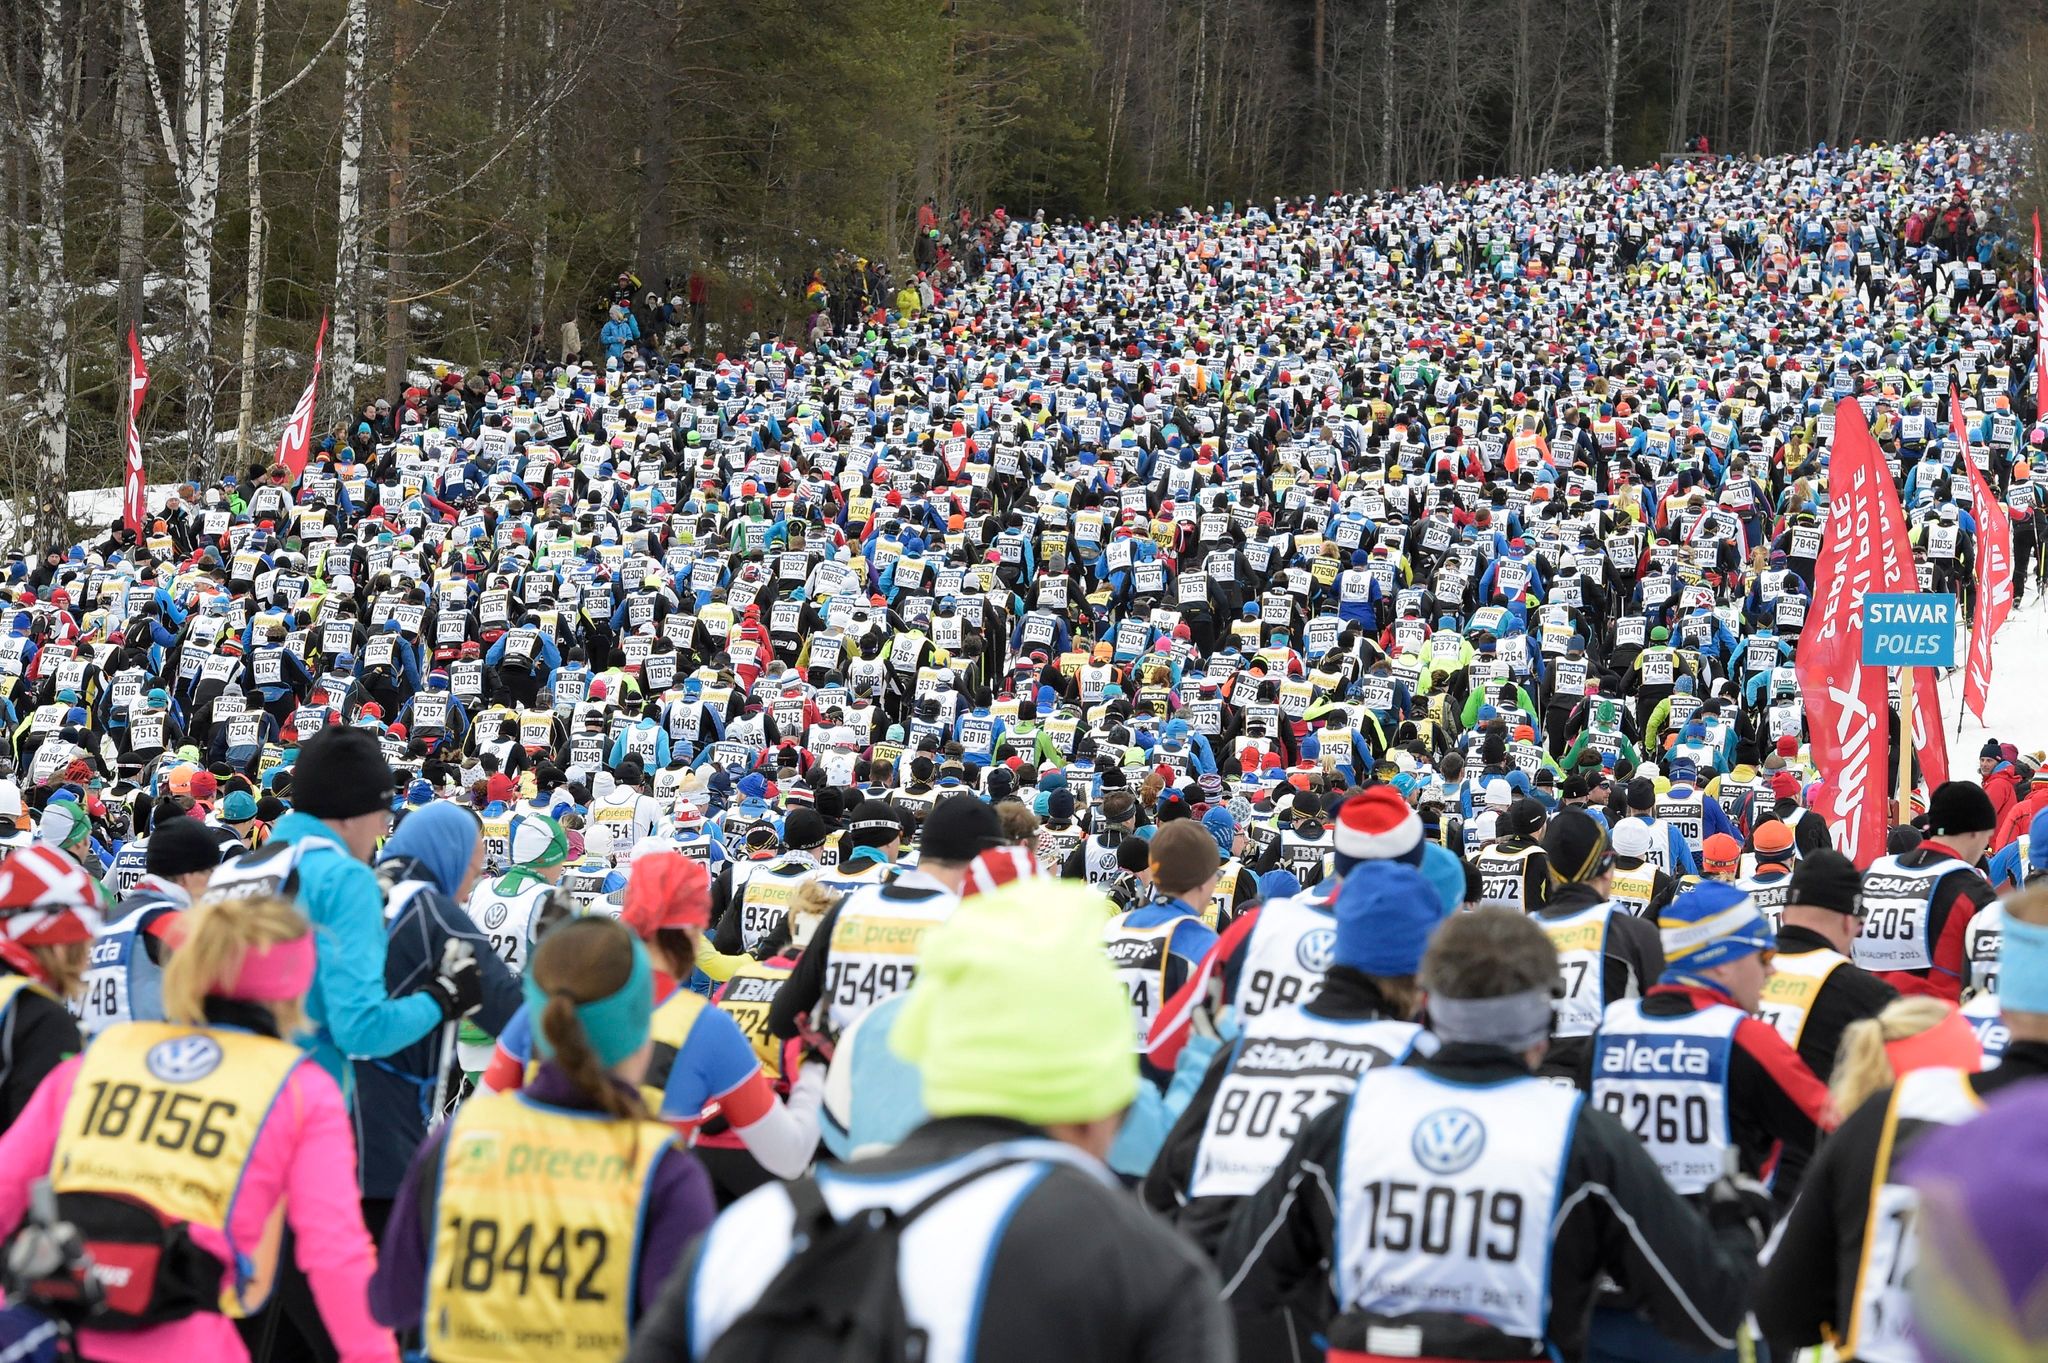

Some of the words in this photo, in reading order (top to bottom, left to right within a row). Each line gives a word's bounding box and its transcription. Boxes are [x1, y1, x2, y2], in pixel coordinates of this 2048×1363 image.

[852, 506, 868, 515] 17121
[1079, 523, 1098, 532] 7621
[1203, 524, 1224, 532] 7993
[1427, 530, 1448, 544] 9042
[1043, 543, 1063, 552] 17903
[1795, 538, 1816, 550] 7845
[1932, 539, 1952, 549] 11035
[1612, 548, 1633, 558] 7523
[783, 562, 804, 570] 13927
[1211, 563, 1231, 573] 8646
[1368, 563, 1392, 571] alecta
[624, 570, 644, 579] 12309
[1314, 566, 1335, 577] 17690
[1501, 570, 1523, 580] 8687
[693, 572, 715, 582] 12904
[821, 572, 843, 584] 10835
[1138, 573, 1160, 583] 14674
[1182, 584, 1204, 593] 7859
[1346, 583, 1365, 594] 11013
[1440, 583, 1463, 595] 6265
[730, 593, 751, 603] 7937
[483, 602, 503, 613] 12615
[586, 599, 607, 609] 15398
[1265, 608, 1287, 618] 13267
[1779, 606, 1802, 617] 10299
[1870, 604, 1947, 624] STAVAR
[397, 613, 419, 624] 7076
[776, 613, 795, 622] 7061
[439, 623, 462, 632] 10720
[1027, 625, 1050, 637] 8350
[666, 628, 689, 638] 7940
[936, 630, 957, 640] 6108
[1311, 632, 1334, 643] 8063
[1399, 630, 1422, 640] 8796
[326, 634, 347, 643] 7091
[815, 639, 838, 647] alecta
[1120, 634, 1142, 646] 9504
[1875, 634, 1940, 654] POLES
[183, 649, 208, 659] alecta
[368, 646, 388, 656] 11325
[625, 646, 644, 656] 7939
[731, 647, 752, 655] 10516
[816, 648, 835, 659] 7123
[892, 649, 914, 662] 7367
[1750, 650, 1774, 662] 10775
[256, 663, 276, 674] 8167
[651, 667, 671, 679] 11913
[1558, 664, 1583, 672] alecta
[1646, 664, 1669, 674] 7495
[58, 672, 79, 682] 8418
[455, 675, 478, 685] 9029
[855, 674, 880, 686] 13082
[1560, 674, 1581, 685] 11964
[115, 686, 136, 696] 9186
[558, 684, 581, 694] 9169
[1085, 682, 1105, 692] 11187
[1364, 689, 1390, 702] 8674
[1282, 697, 1306, 707] 7789
[417, 706, 442, 716] 7957
[1192, 704, 1220, 712] alecta
[774, 712, 799, 723] 7943
[1194, 714, 1216, 724] 7129
[914, 725, 942, 735] alecta
[965, 721, 989, 729] alecta
[135, 727, 158, 738] 7513
[230, 725, 254, 736] 7504
[524, 726, 546, 737] 11507
[963, 732, 986, 743] 6818
[718, 745, 745, 753] alecta
[1322, 744, 1348, 754] 13457
[574, 751, 600, 762] 10349
[900, 799, 924, 810] IBM
[1293, 847, 1324, 860] IBM
[1479, 862, 1519, 873] stadium
[1864, 877, 1915, 892] CRAFT
[1749, 889, 1787, 903] IBM
[730, 979, 784, 1002] IBM
[1236, 1040, 1373, 1072] stadium
[1602, 1039, 1709, 1074] alecta
[1216, 1090, 1343, 1137] 803
[82, 1080, 237, 1159] 18156
[1364, 1182, 1522, 1262] 15019
[447, 1217, 607, 1300] 18442
